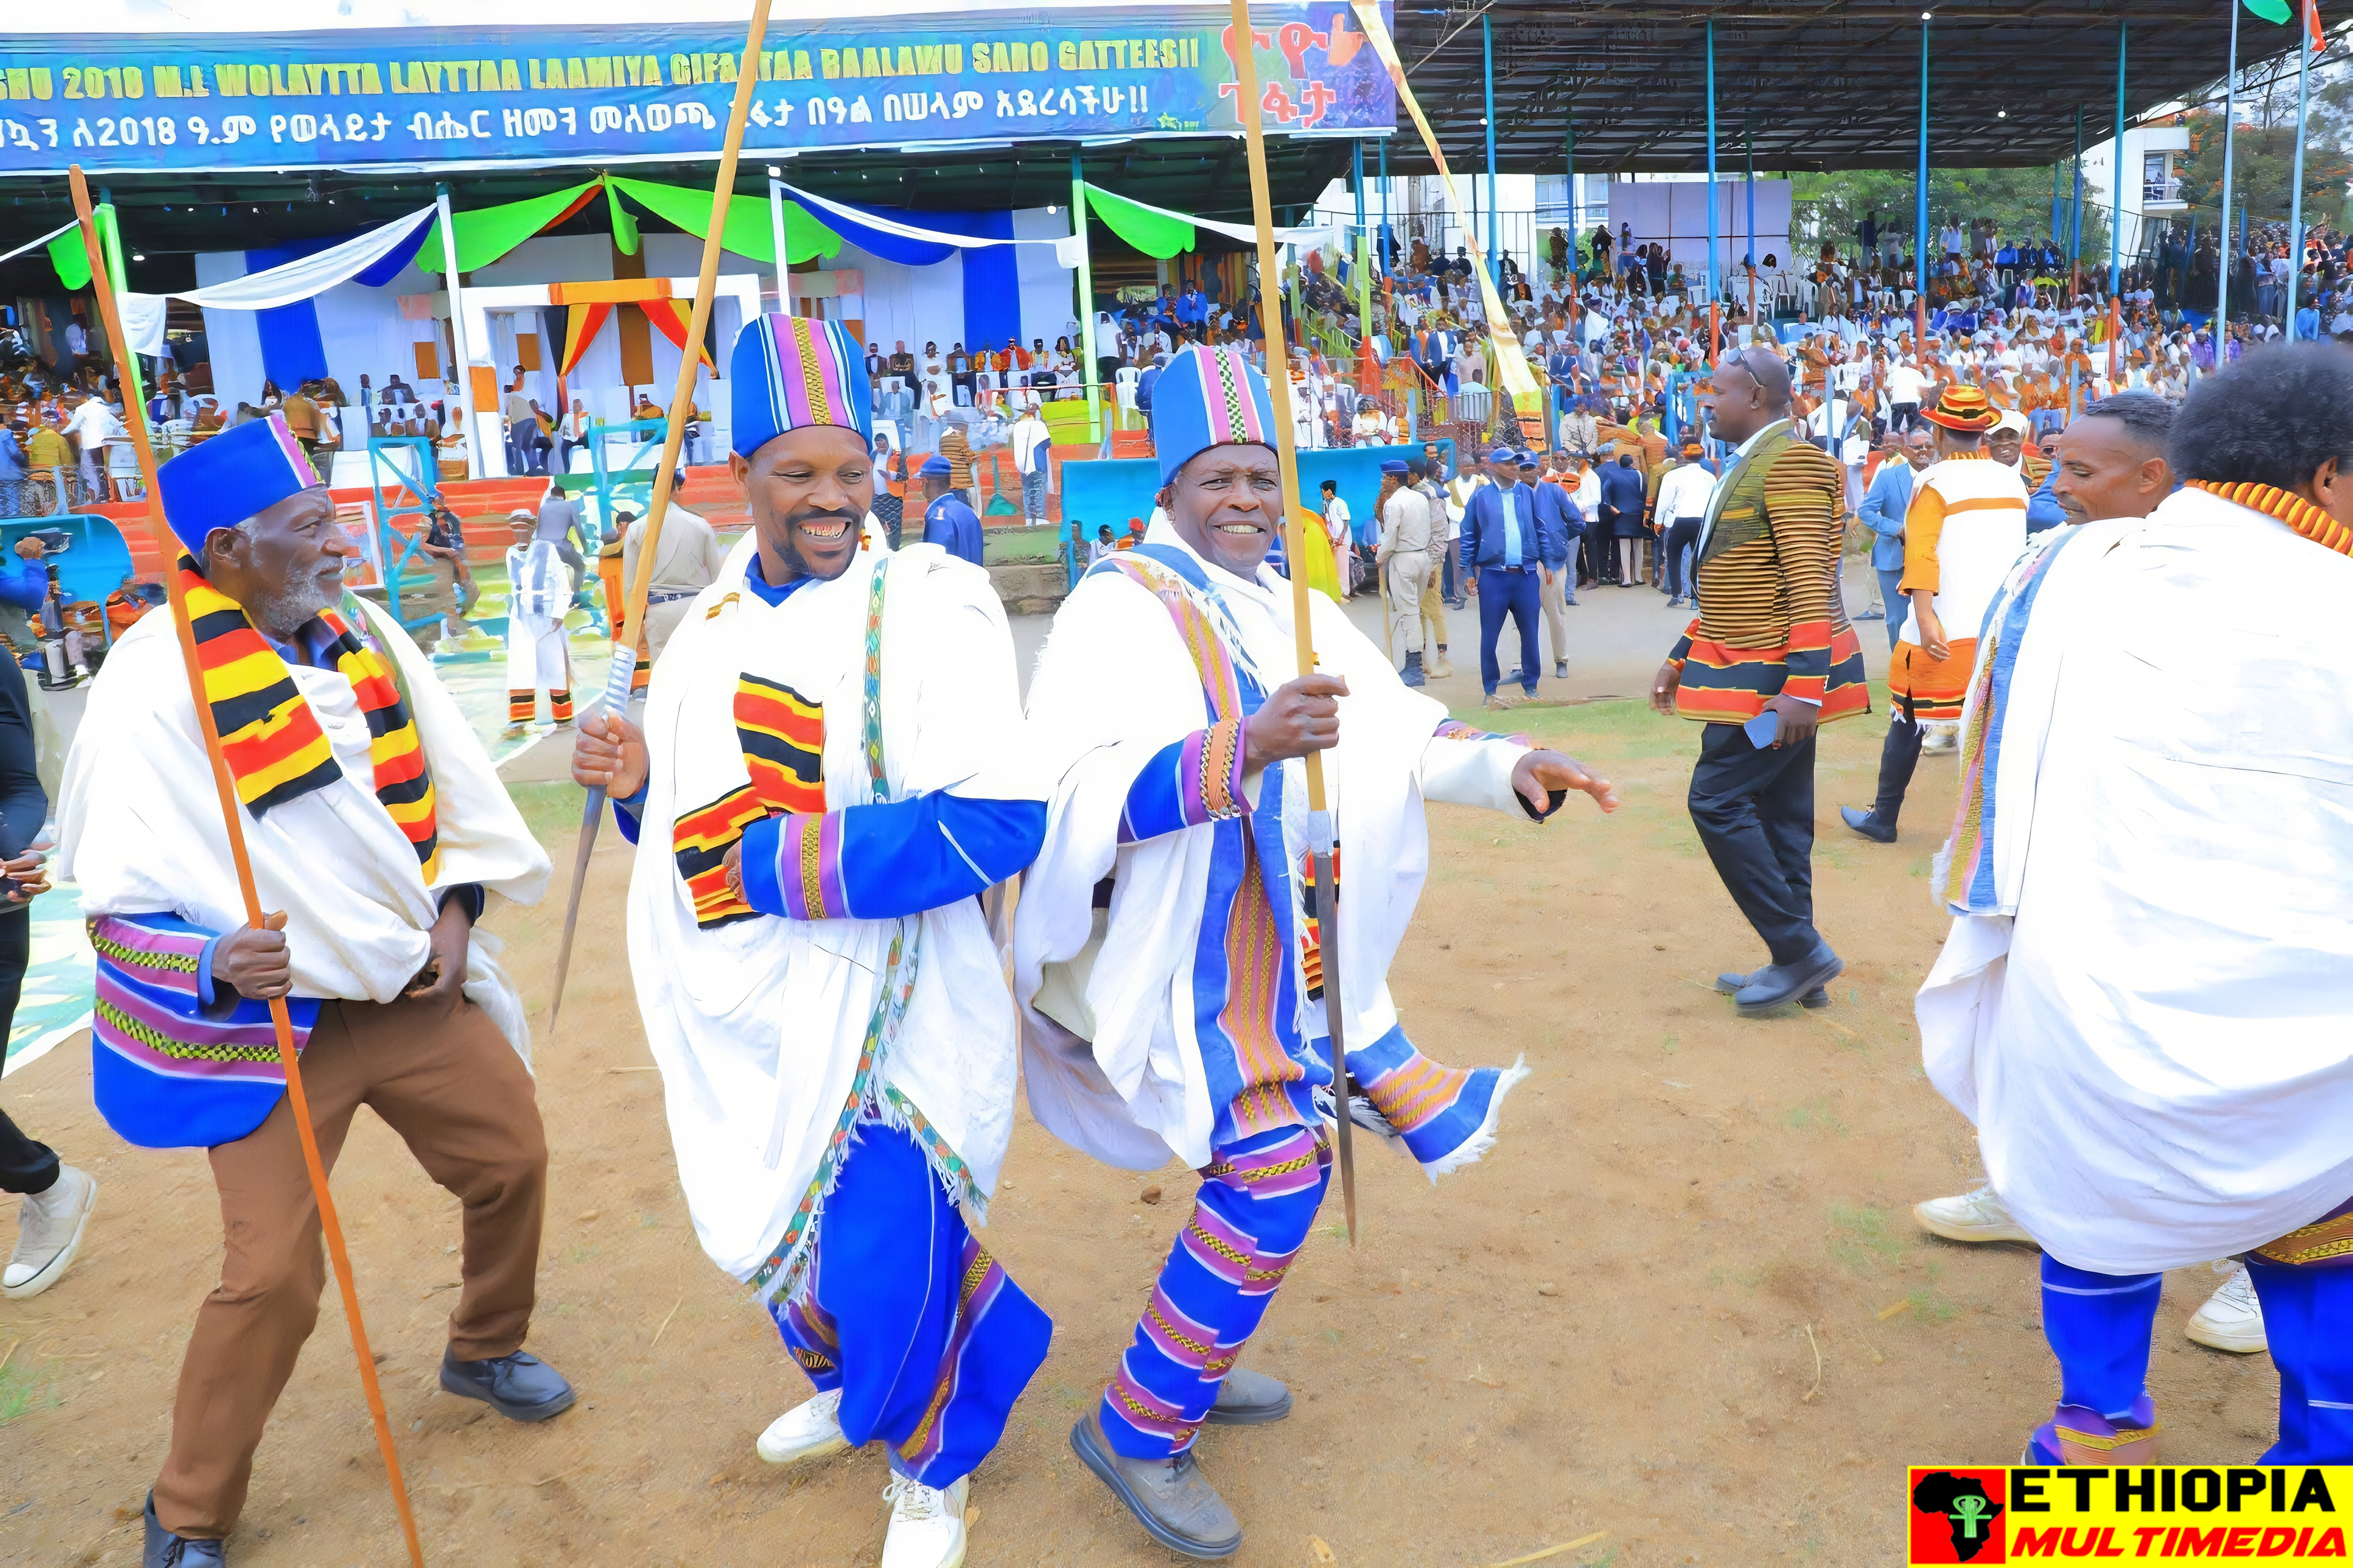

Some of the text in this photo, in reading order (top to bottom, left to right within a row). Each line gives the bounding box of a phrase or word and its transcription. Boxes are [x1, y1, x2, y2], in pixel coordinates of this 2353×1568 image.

[214, 63, 384, 97] WOLAYTTA
[389, 59, 523, 94] LAYTTAA
[528, 55, 663, 89] LAAMIYA
[671, 49, 813, 85] GIFATAA
[0, 119, 58, 151] ኳን
[73, 116, 177, 147] ለ2018
[270, 112, 392, 144] የወላይታ
[502, 107, 576, 137] ዘመን
[590, 102, 716, 133] መለወጫ
[728, 98, 794, 128] ፋታ
[808, 95, 873, 125] በዓል
[884, 90, 984, 122] በሠላም
